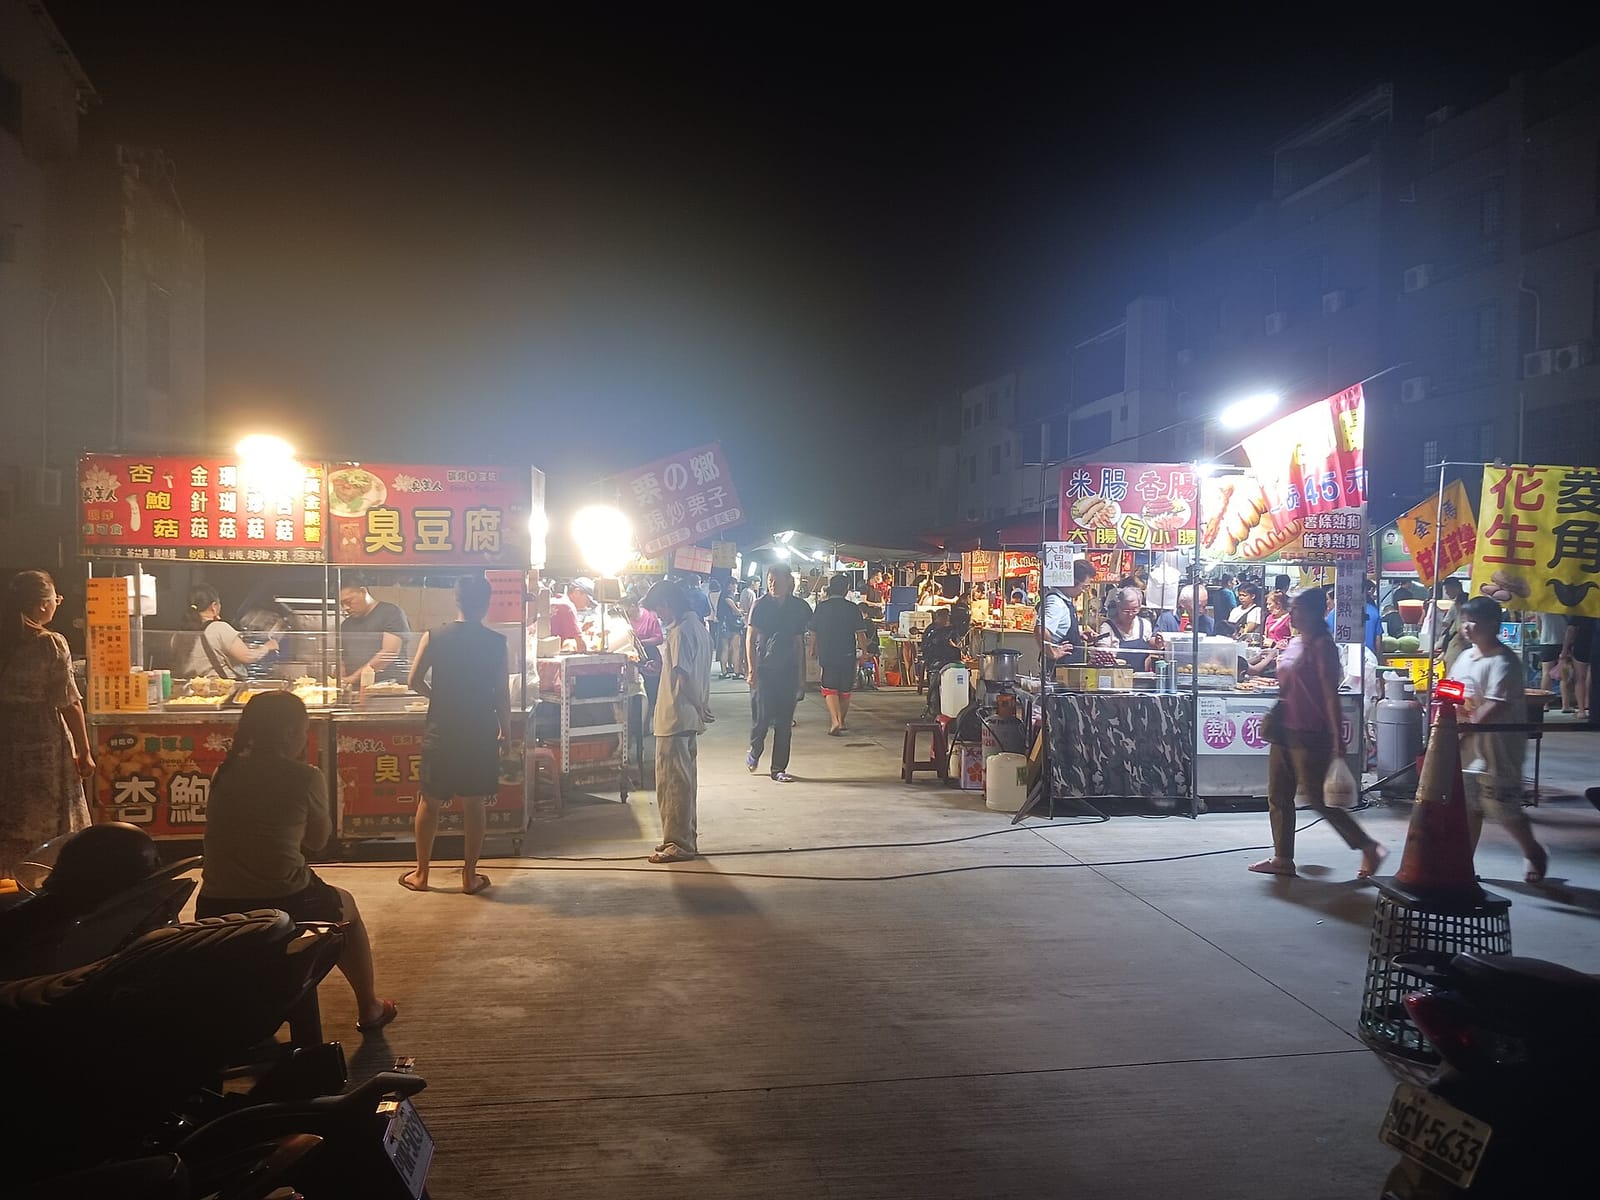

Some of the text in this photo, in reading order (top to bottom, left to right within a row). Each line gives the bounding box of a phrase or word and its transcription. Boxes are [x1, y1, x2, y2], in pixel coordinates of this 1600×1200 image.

[129, 463, 180, 539] 杏鮑菇
[190, 465, 209, 539] 金針菇
[1303, 513, 1361, 530] 薯條熱狗
[1482, 467, 1545, 566] 花生
[365, 507, 502, 553] 臭豆腐
[1067, 515, 1197, 549] 大腸包小腸
[1303, 532, 1360, 549] 旋轉熱狗
